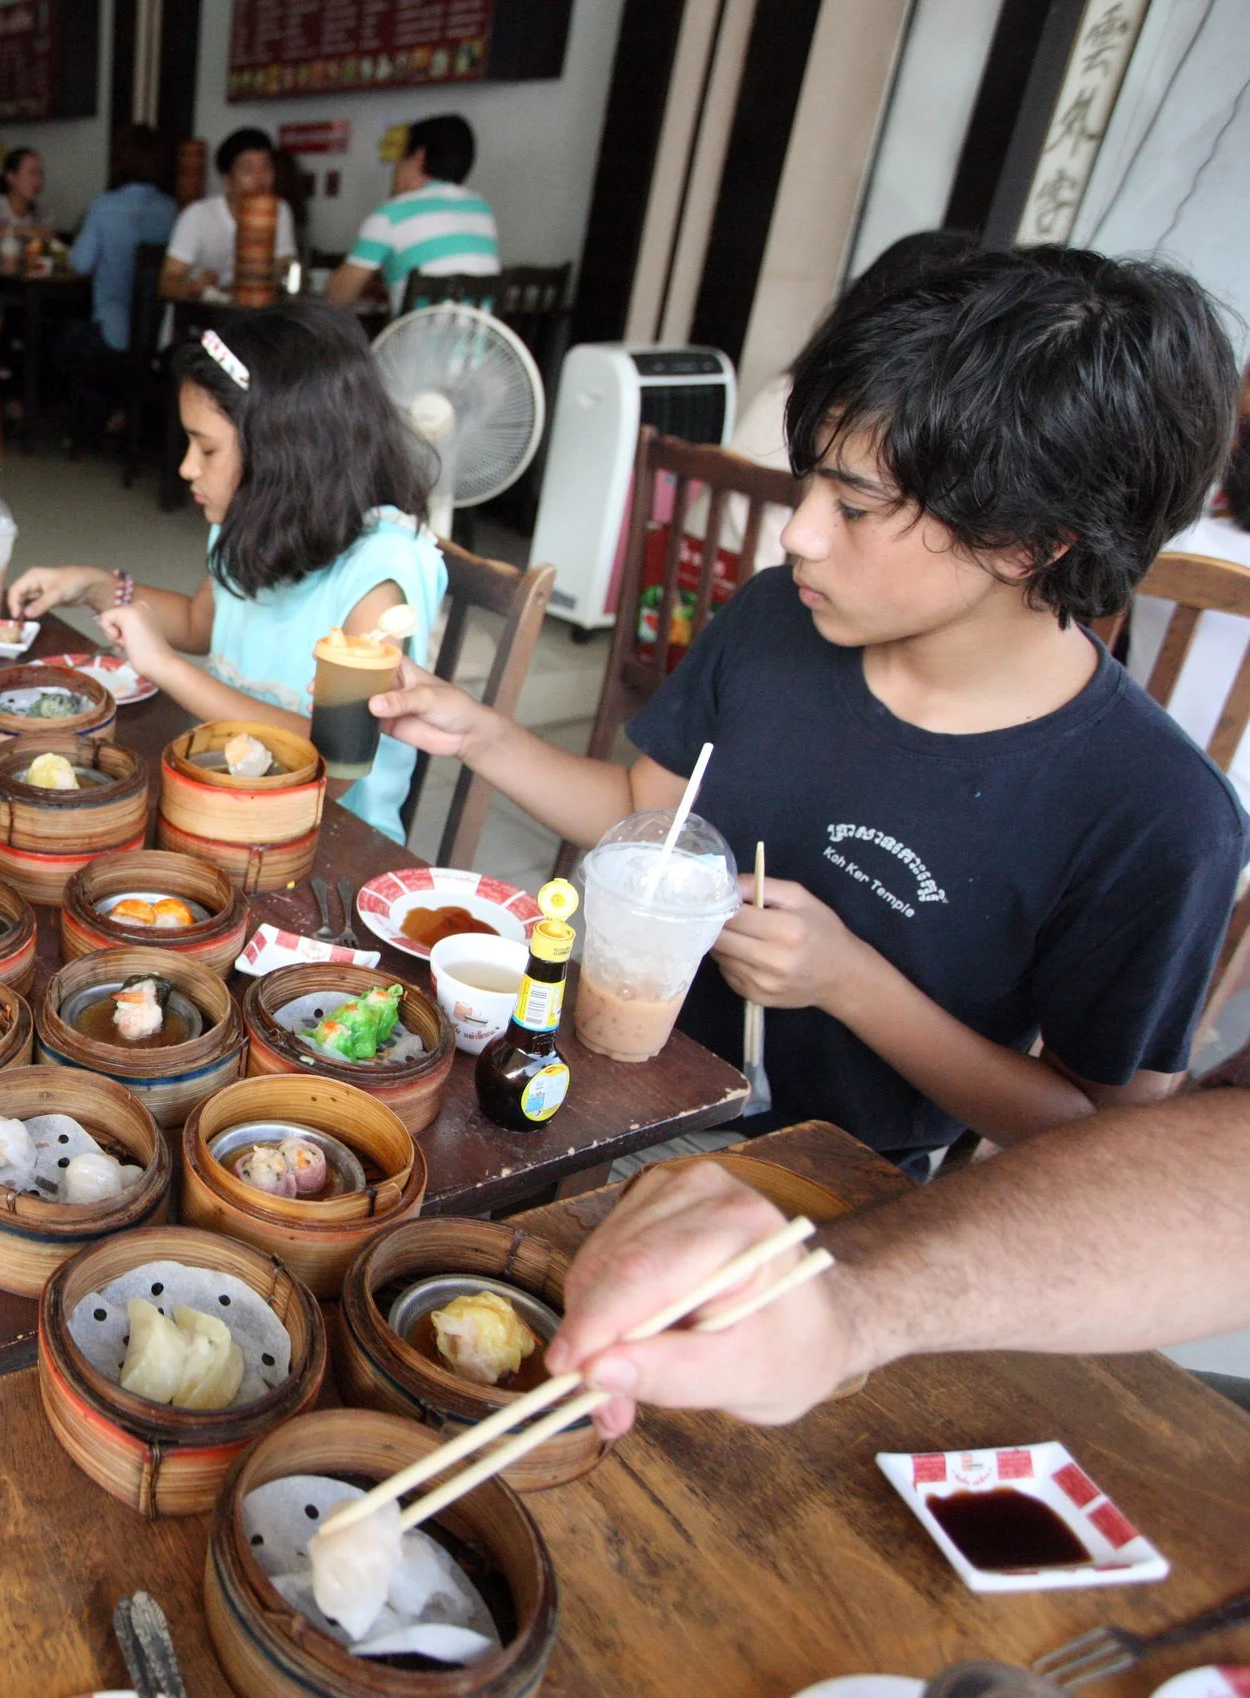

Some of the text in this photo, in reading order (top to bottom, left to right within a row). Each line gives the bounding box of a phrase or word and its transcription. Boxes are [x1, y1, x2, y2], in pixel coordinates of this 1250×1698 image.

[823, 846, 915, 918] Koh Ker Temple
